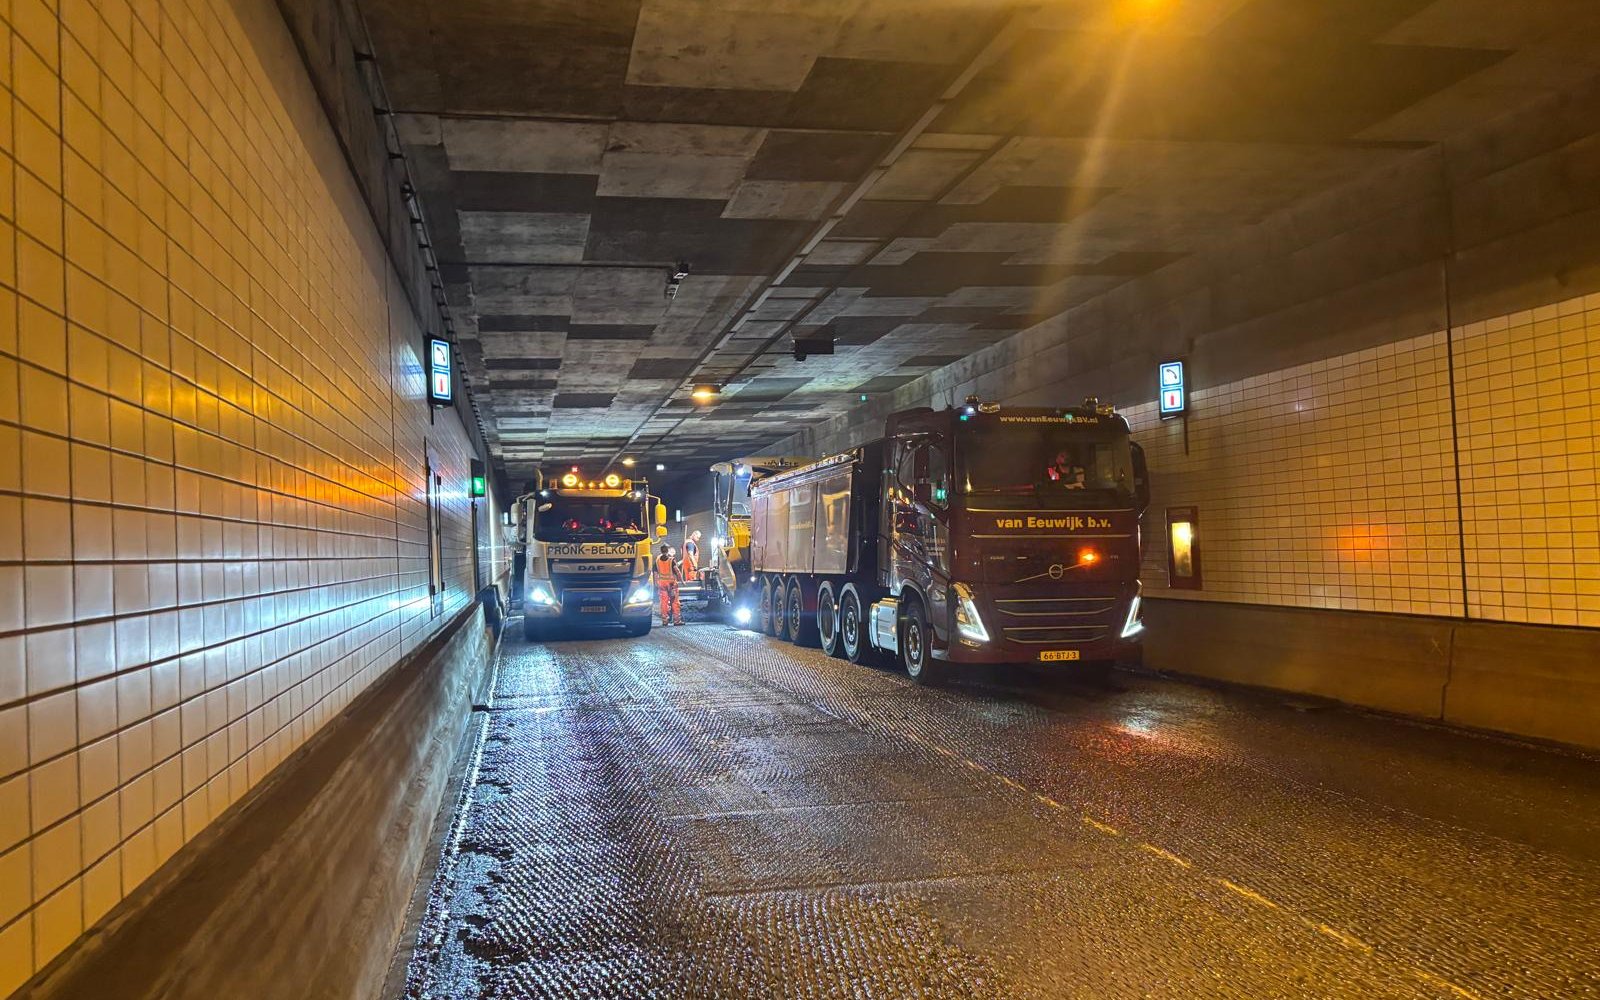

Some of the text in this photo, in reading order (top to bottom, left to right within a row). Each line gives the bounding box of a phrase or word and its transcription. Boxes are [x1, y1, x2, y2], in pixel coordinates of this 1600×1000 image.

[996, 516, 1112, 531] van Eeuwijk b.v.
[547, 545, 635, 555] PRONK-BELKOM
